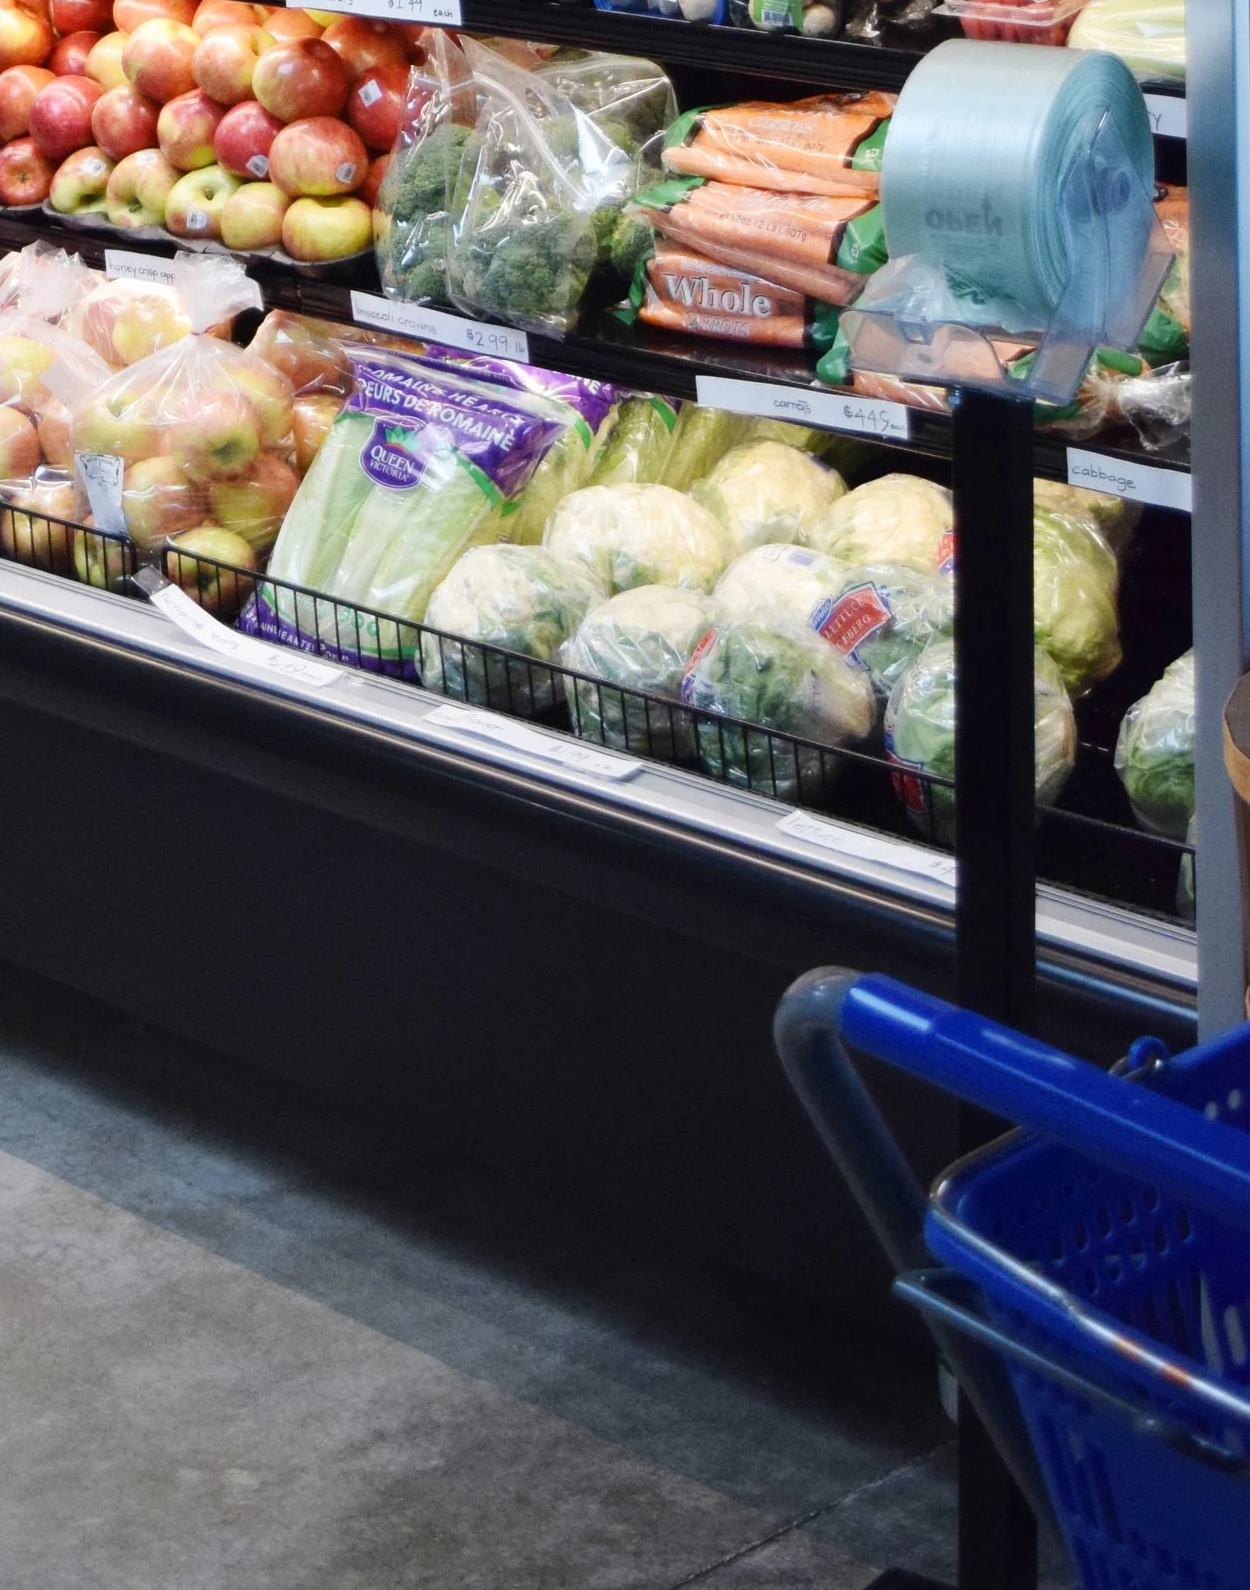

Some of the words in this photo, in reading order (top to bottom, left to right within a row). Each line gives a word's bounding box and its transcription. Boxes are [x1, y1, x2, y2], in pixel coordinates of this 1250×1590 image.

[433, 9, 454, 18] each
[663, 272, 773, 319] Whole
[355, 300, 395, 324] broccoli
[397, 316, 438, 336] crowns
[514, 340, 527, 354] lb
[403, 390, 428, 412] DE
[426, 400, 517, 452] ROMAINE
[773, 398, 812, 415] carrots
[368, 460, 409, 481] VICTORIA
[369, 444, 416, 475] QUEEN
[1072, 457, 1137, 492] cabbage
[823, 595, 865, 640] LETTUCE
